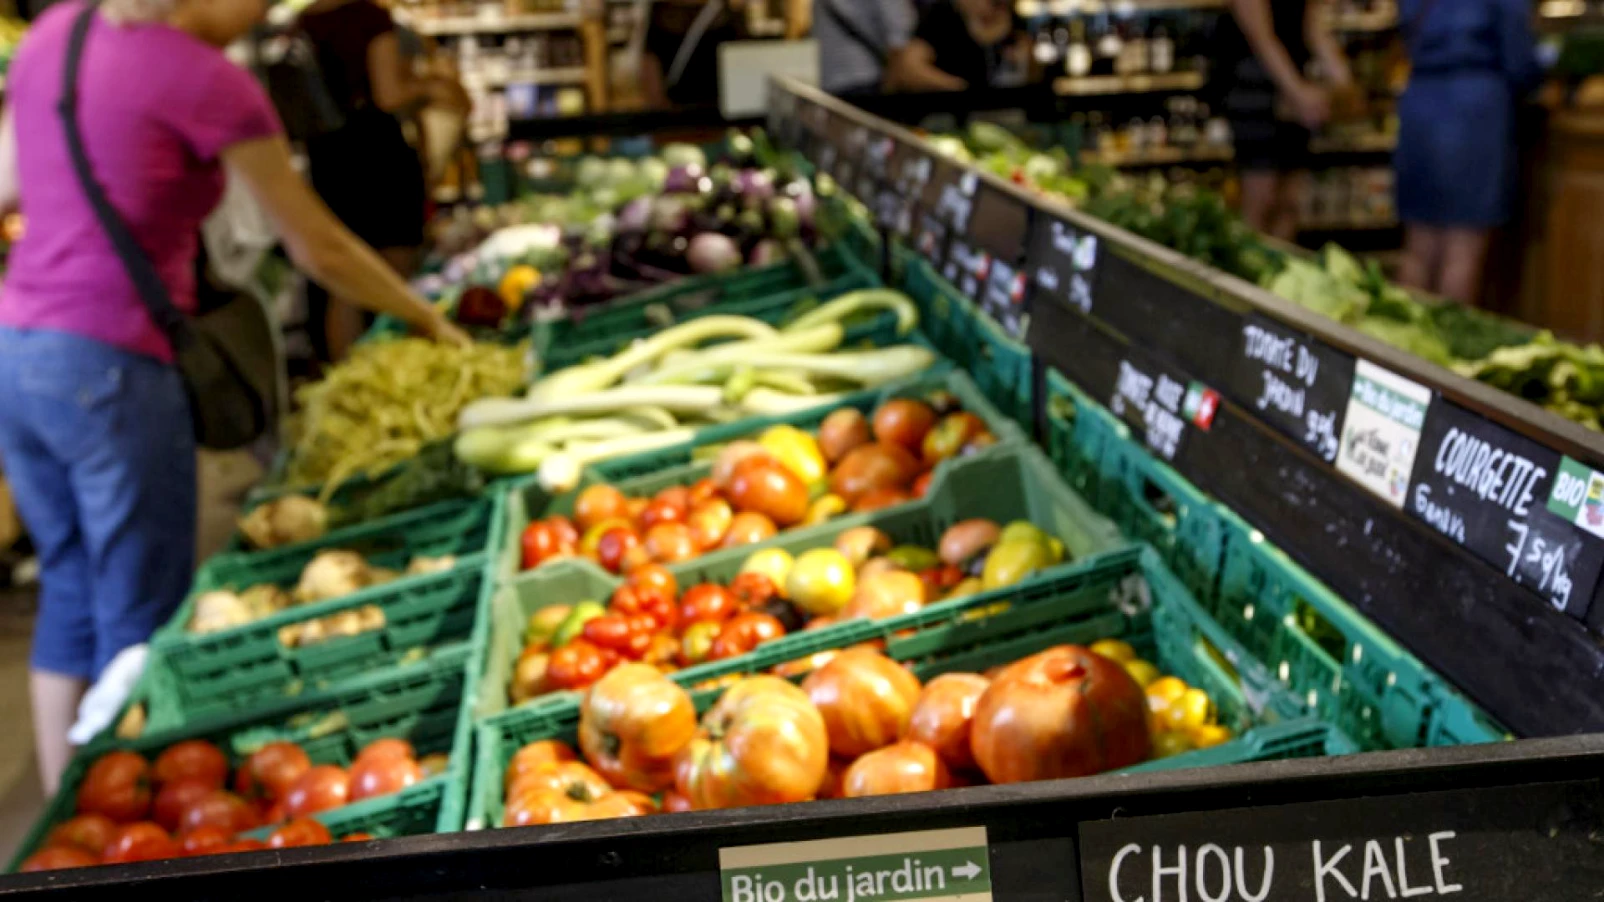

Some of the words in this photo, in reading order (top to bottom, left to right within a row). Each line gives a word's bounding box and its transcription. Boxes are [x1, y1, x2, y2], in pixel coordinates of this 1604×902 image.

[1434, 427, 1547, 515] COURGETTE
[1553, 471, 1586, 508] BIO
[731, 874, 785, 902] Bio
[794, 867, 839, 902] du
[845, 858, 946, 902] jardin
[1108, 843, 1275, 902] CHOU
[1312, 830, 1463, 902] KALE
